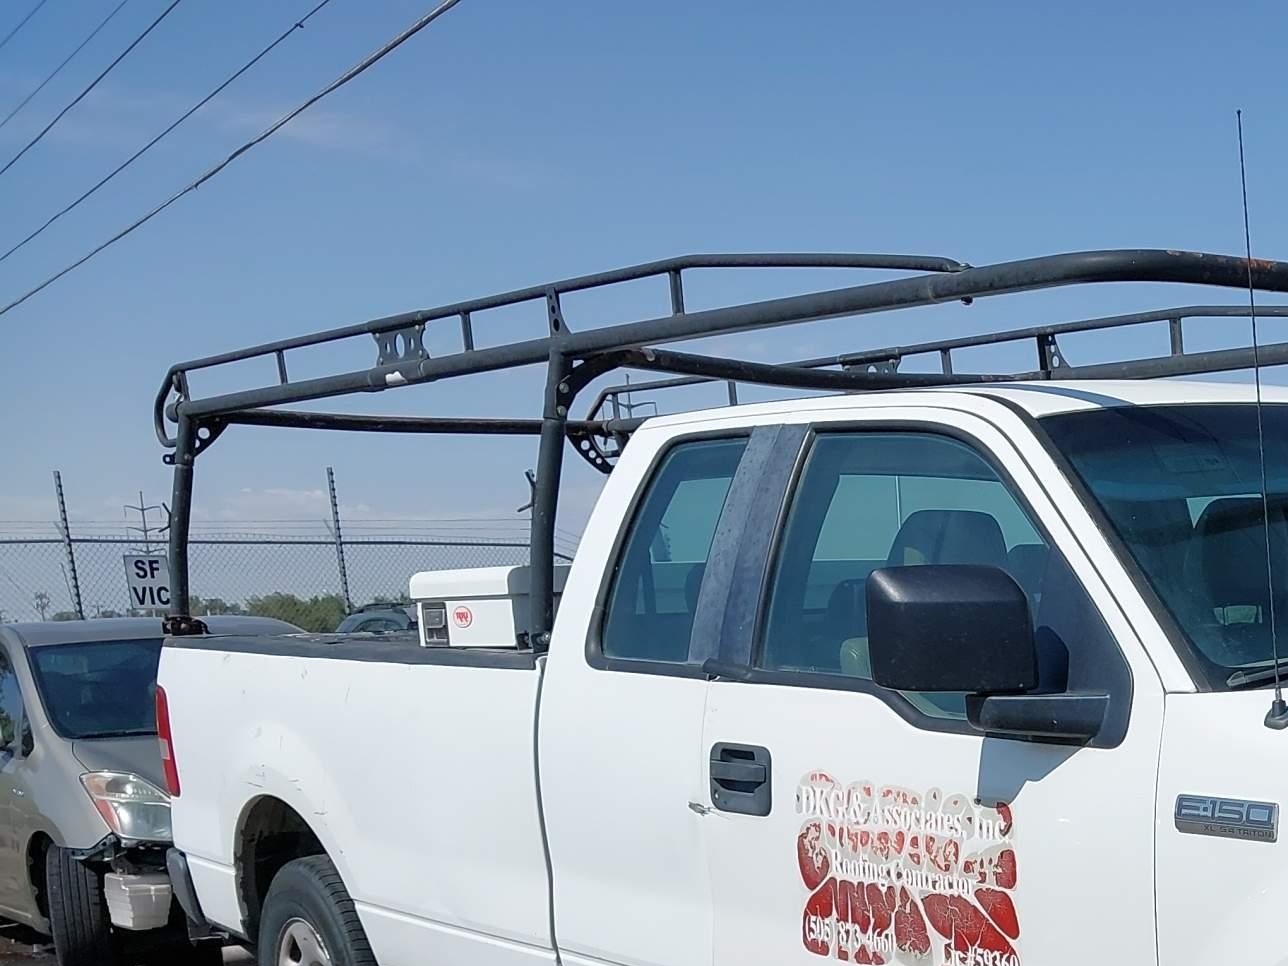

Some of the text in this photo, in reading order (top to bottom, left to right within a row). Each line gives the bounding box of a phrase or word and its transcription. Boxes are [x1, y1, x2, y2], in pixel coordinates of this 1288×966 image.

[134, 560, 159, 579] SF
[132, 586, 169, 605] VIC
[800, 785, 848, 820] DKG
[849, 787, 867, 824] &
[867, 801, 967, 840] Associates,
[1176, 797, 1273, 826] F-150
[831, 849, 978, 897] Roofing Contractor
